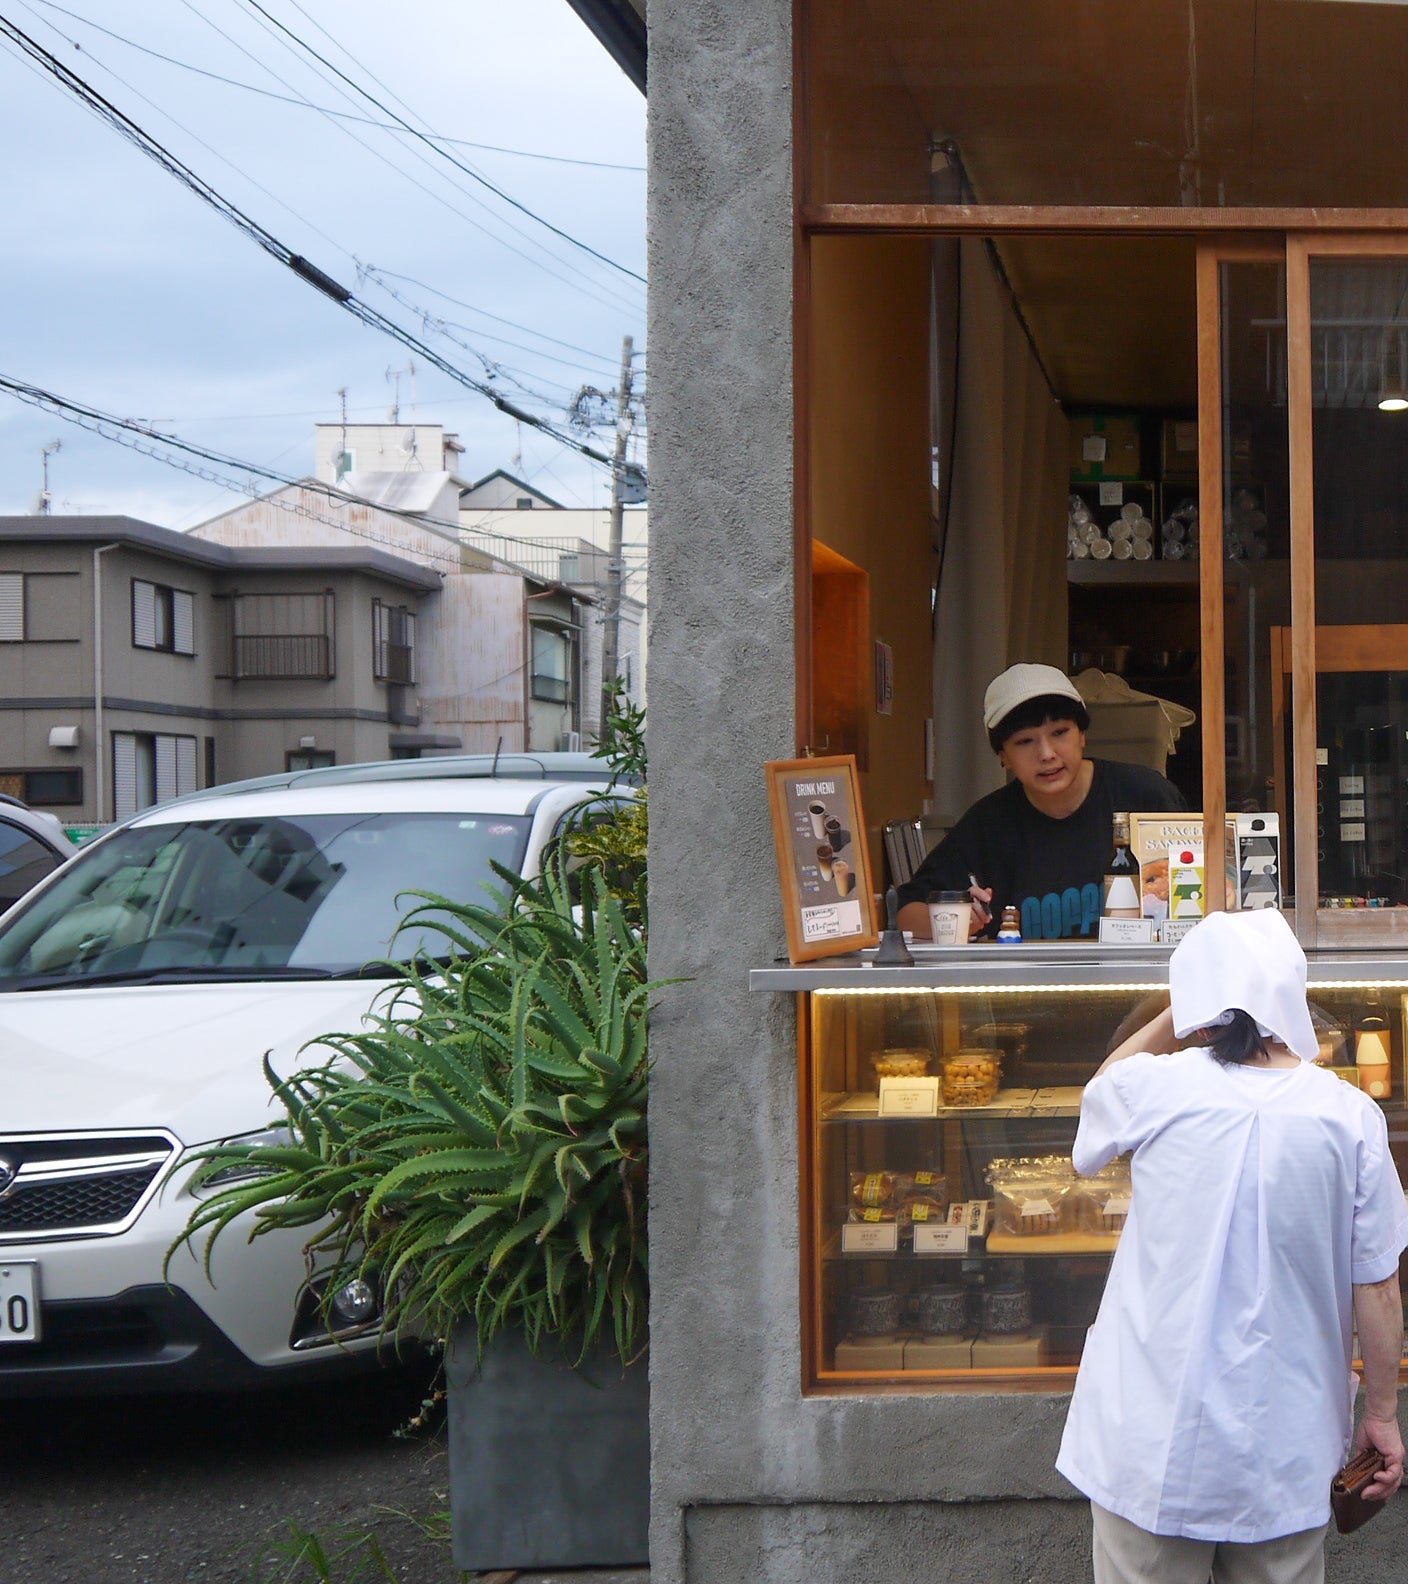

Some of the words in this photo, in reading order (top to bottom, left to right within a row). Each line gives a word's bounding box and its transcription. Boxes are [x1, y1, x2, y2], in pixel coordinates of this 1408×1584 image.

[795, 783, 817, 797] DRINK
[816, 781, 836, 795] MENU
[1021, 882, 1104, 940] COFF
[0, 1294, 28, 1334] 0
